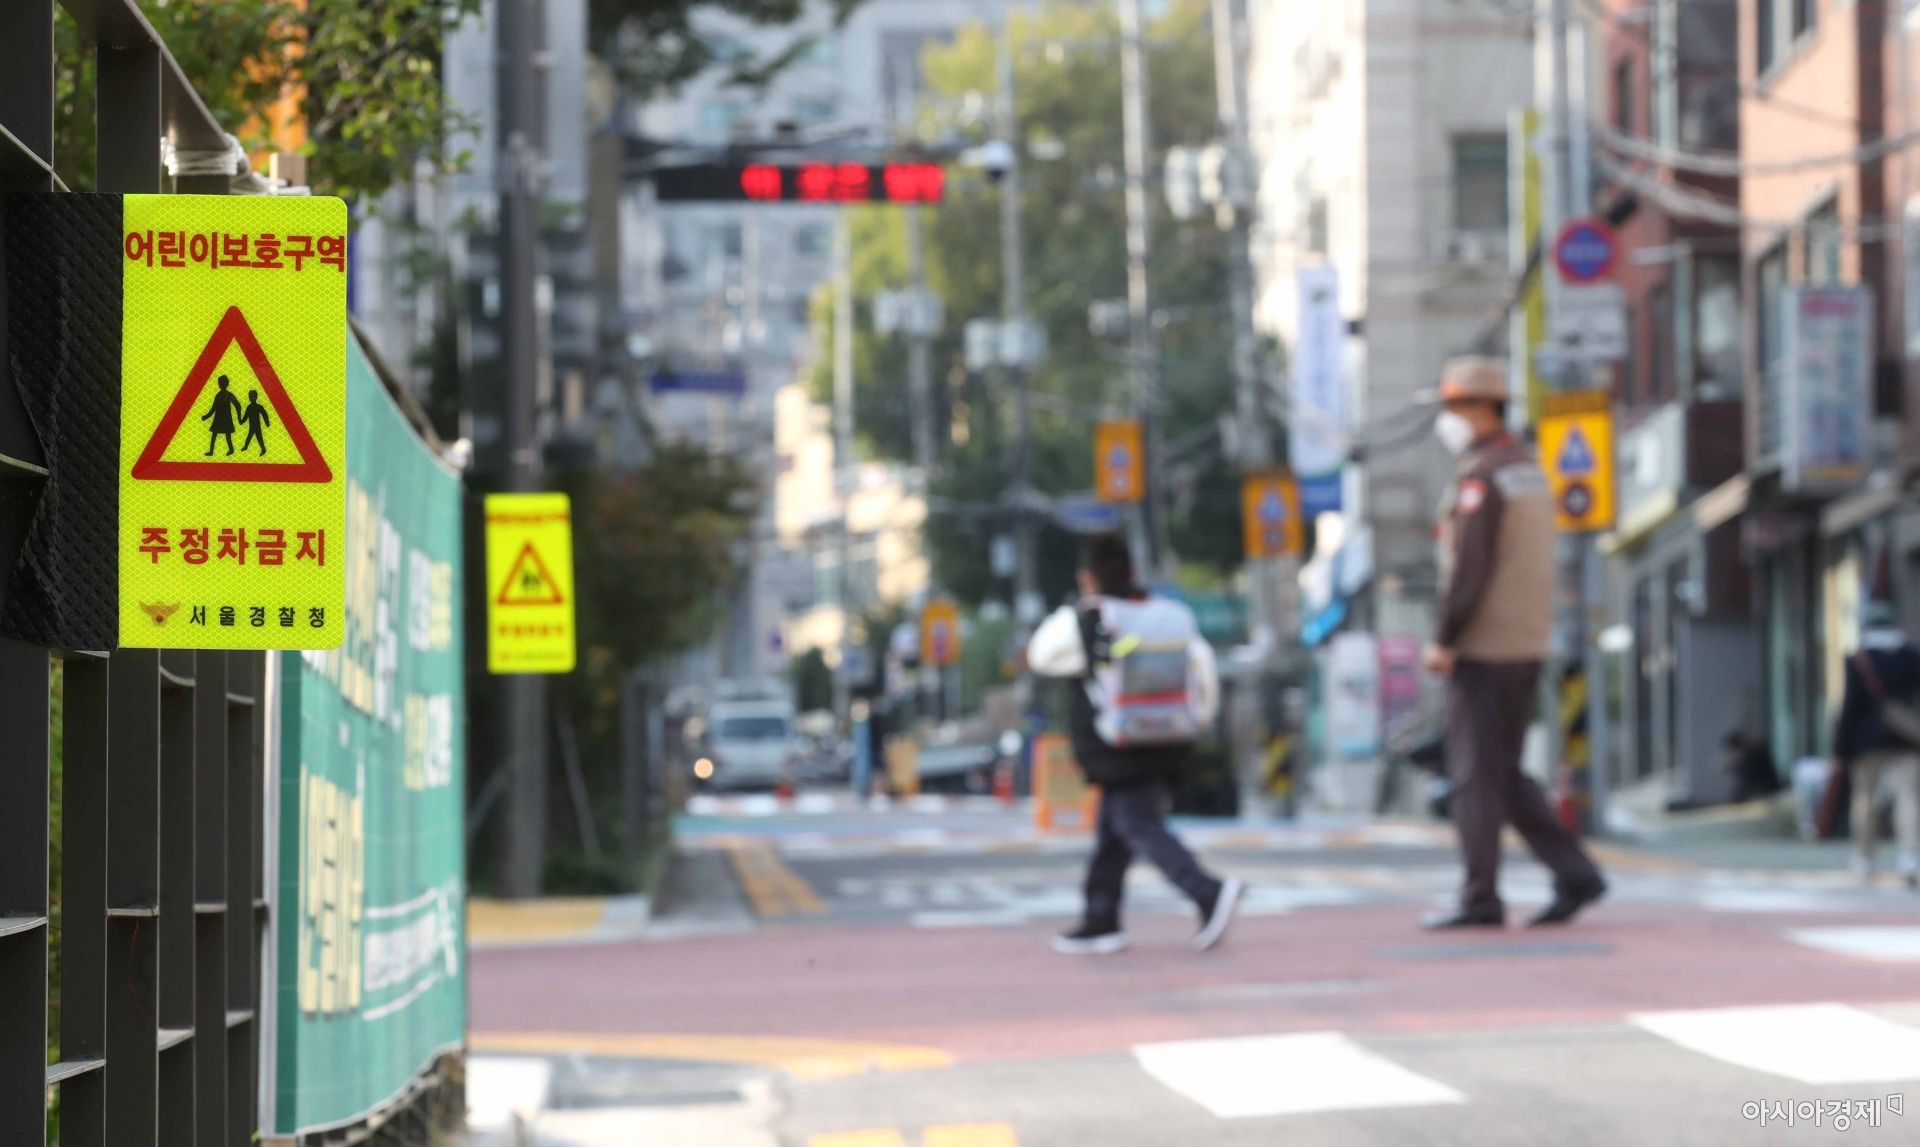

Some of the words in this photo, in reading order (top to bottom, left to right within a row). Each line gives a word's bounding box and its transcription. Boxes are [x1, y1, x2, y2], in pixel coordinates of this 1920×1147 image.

[124, 230, 346, 273] 어린이보호구역
[138, 526, 326, 567] 주정차금지
[189, 604, 326, 629] 서울경찰청
